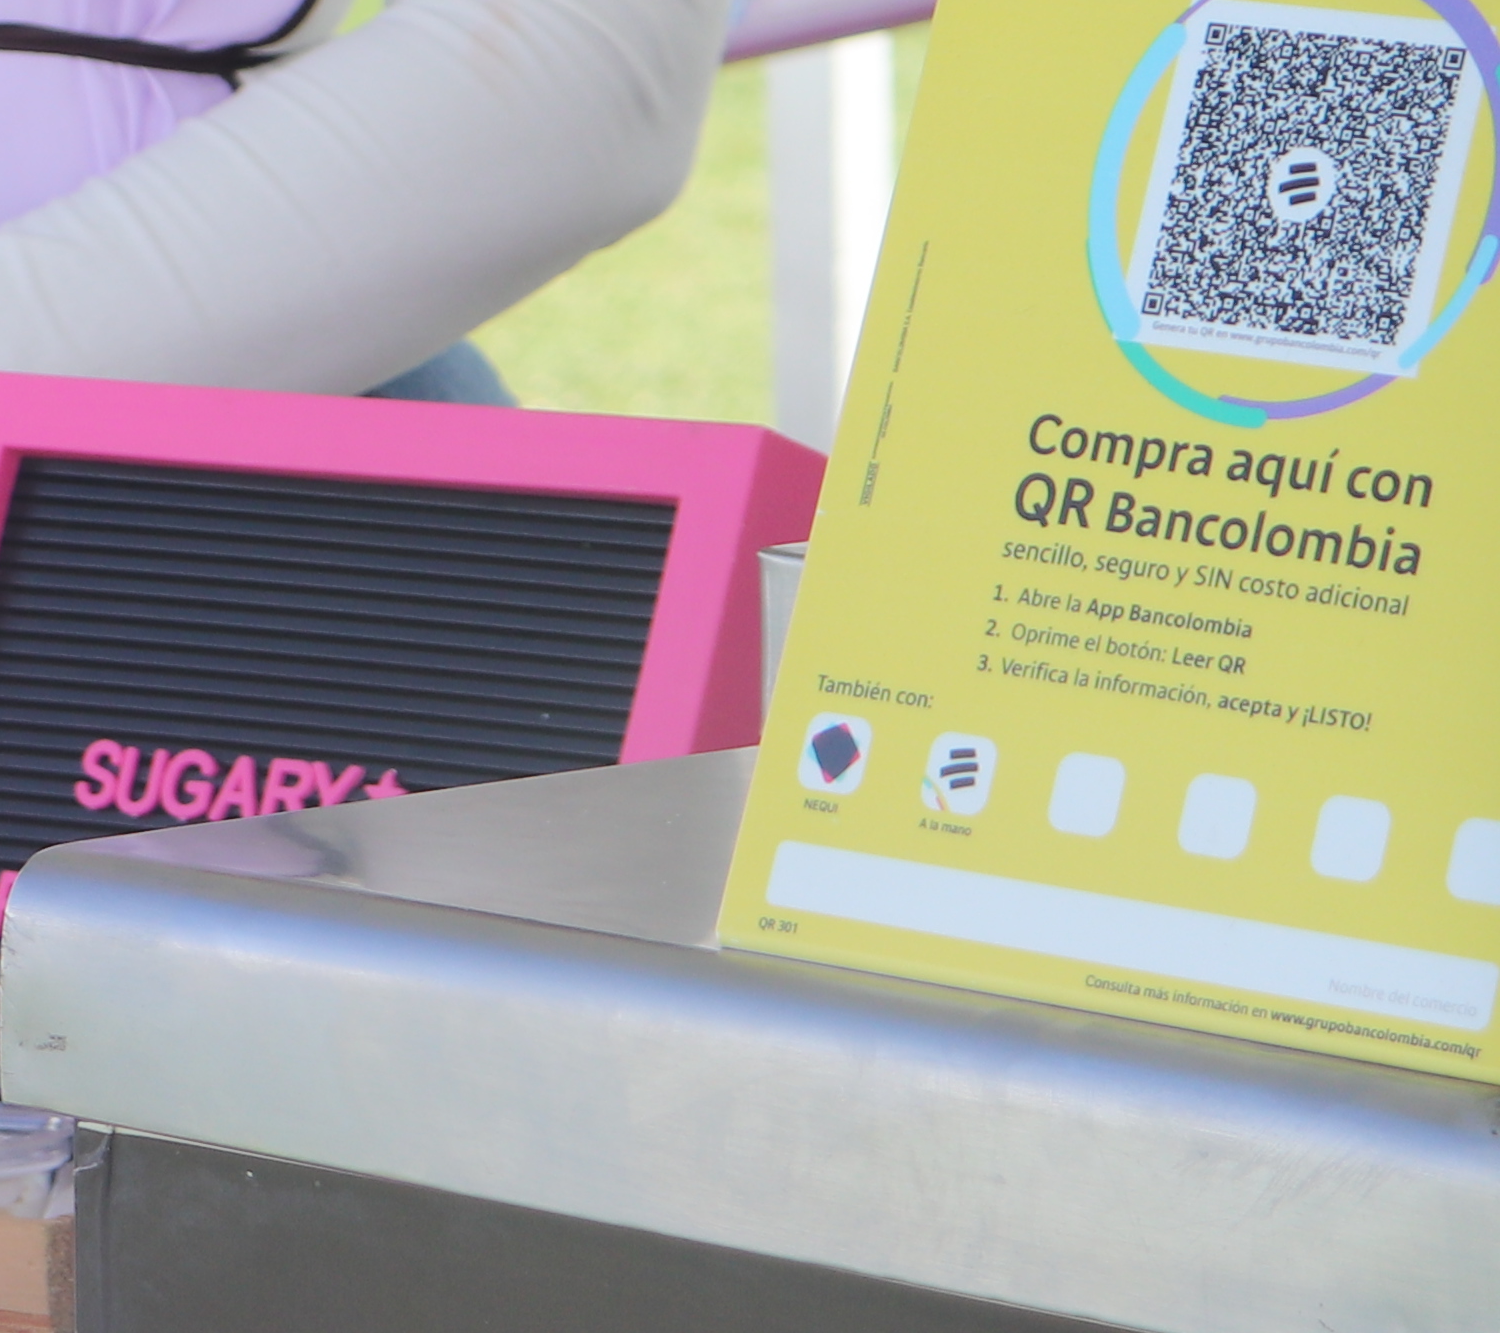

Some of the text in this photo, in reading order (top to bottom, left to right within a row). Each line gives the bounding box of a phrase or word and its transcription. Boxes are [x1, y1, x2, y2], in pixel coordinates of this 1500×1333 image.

[1152, 320, 1186, 334] Genera
[1188, 324, 1198, 335] tu
[1200, 326, 1214, 338] QR
[1216, 331, 1228, 339] en
[1029, 413, 1434, 508] Compra aquí con
[1014, 472, 1422, 576] QR Bancolombia
[1002, 540, 1411, 616] sencillo, seguro y SIN costo adicional
[993, 584, 1254, 640] 1. Abre la App Bancolombia
[985, 619, 1246, 676] 2. Oprime el botón: Leer QR
[817, 674, 935, 710] También con:
[977, 654, 1373, 733] 3. Verifica la información, acepta y ¡LISTO!
[74, 738, 366, 822] SUGARY
[803, 797, 839, 815] NEQUI
[918, 817, 973, 837] A la mano
[758, 916, 799, 934] QR 301
[1085, 973, 1483, 1061] Consulta más información en www.grupobancolombia.com/qr
[1327, 977, 1479, 1019] Nombre del comercio
